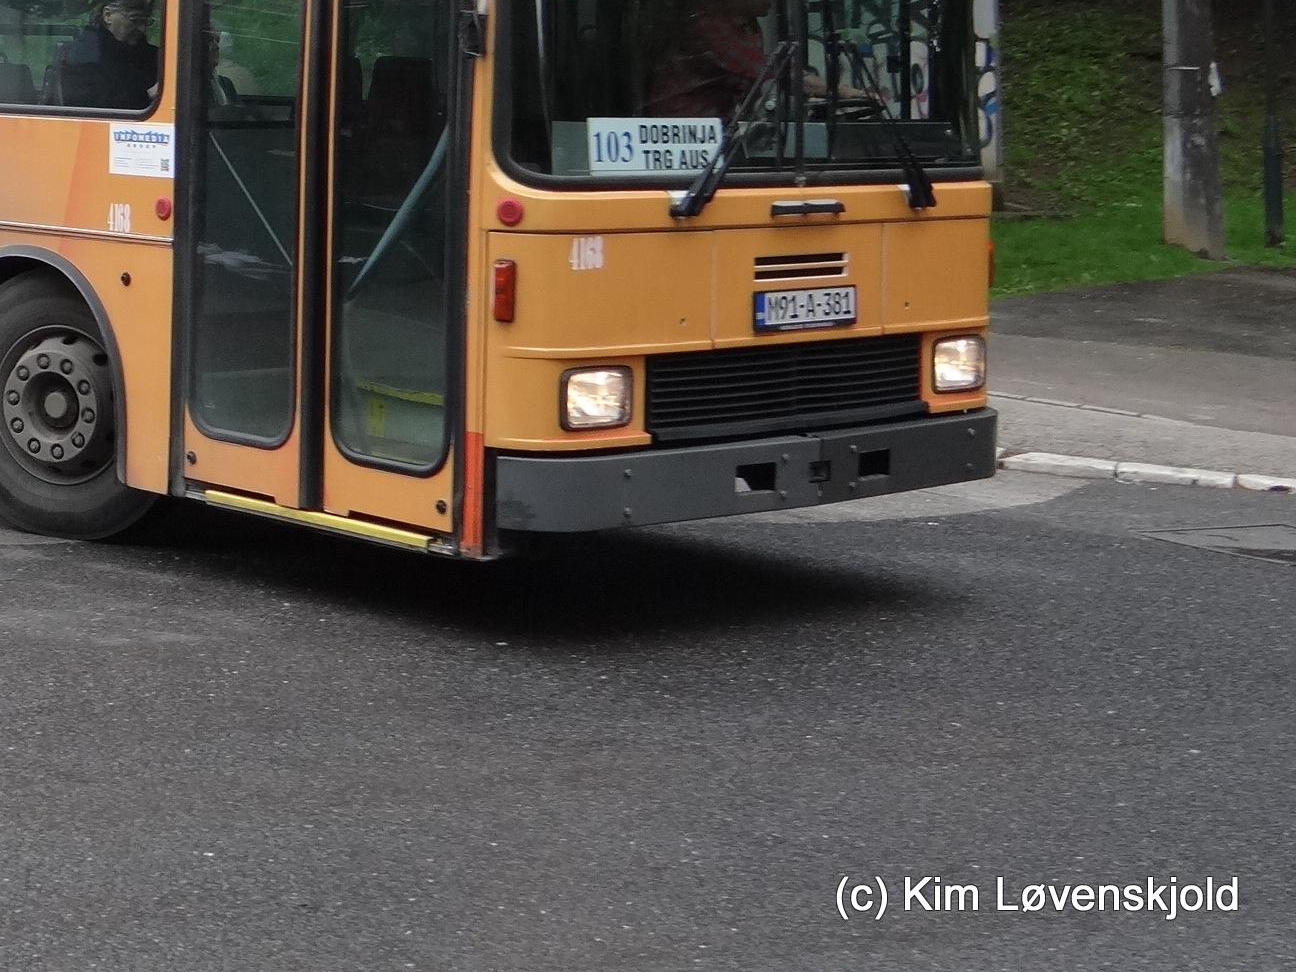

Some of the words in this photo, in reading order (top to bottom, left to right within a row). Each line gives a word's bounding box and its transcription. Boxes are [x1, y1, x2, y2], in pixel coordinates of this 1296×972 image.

[114, 131, 170, 144] INFOMEDIA
[639, 124, 717, 145] DOBRINJA
[593, 131, 634, 163] 103
[642, 149, 674, 170] TRG
[766, 291, 852, 321] M91-A-381
